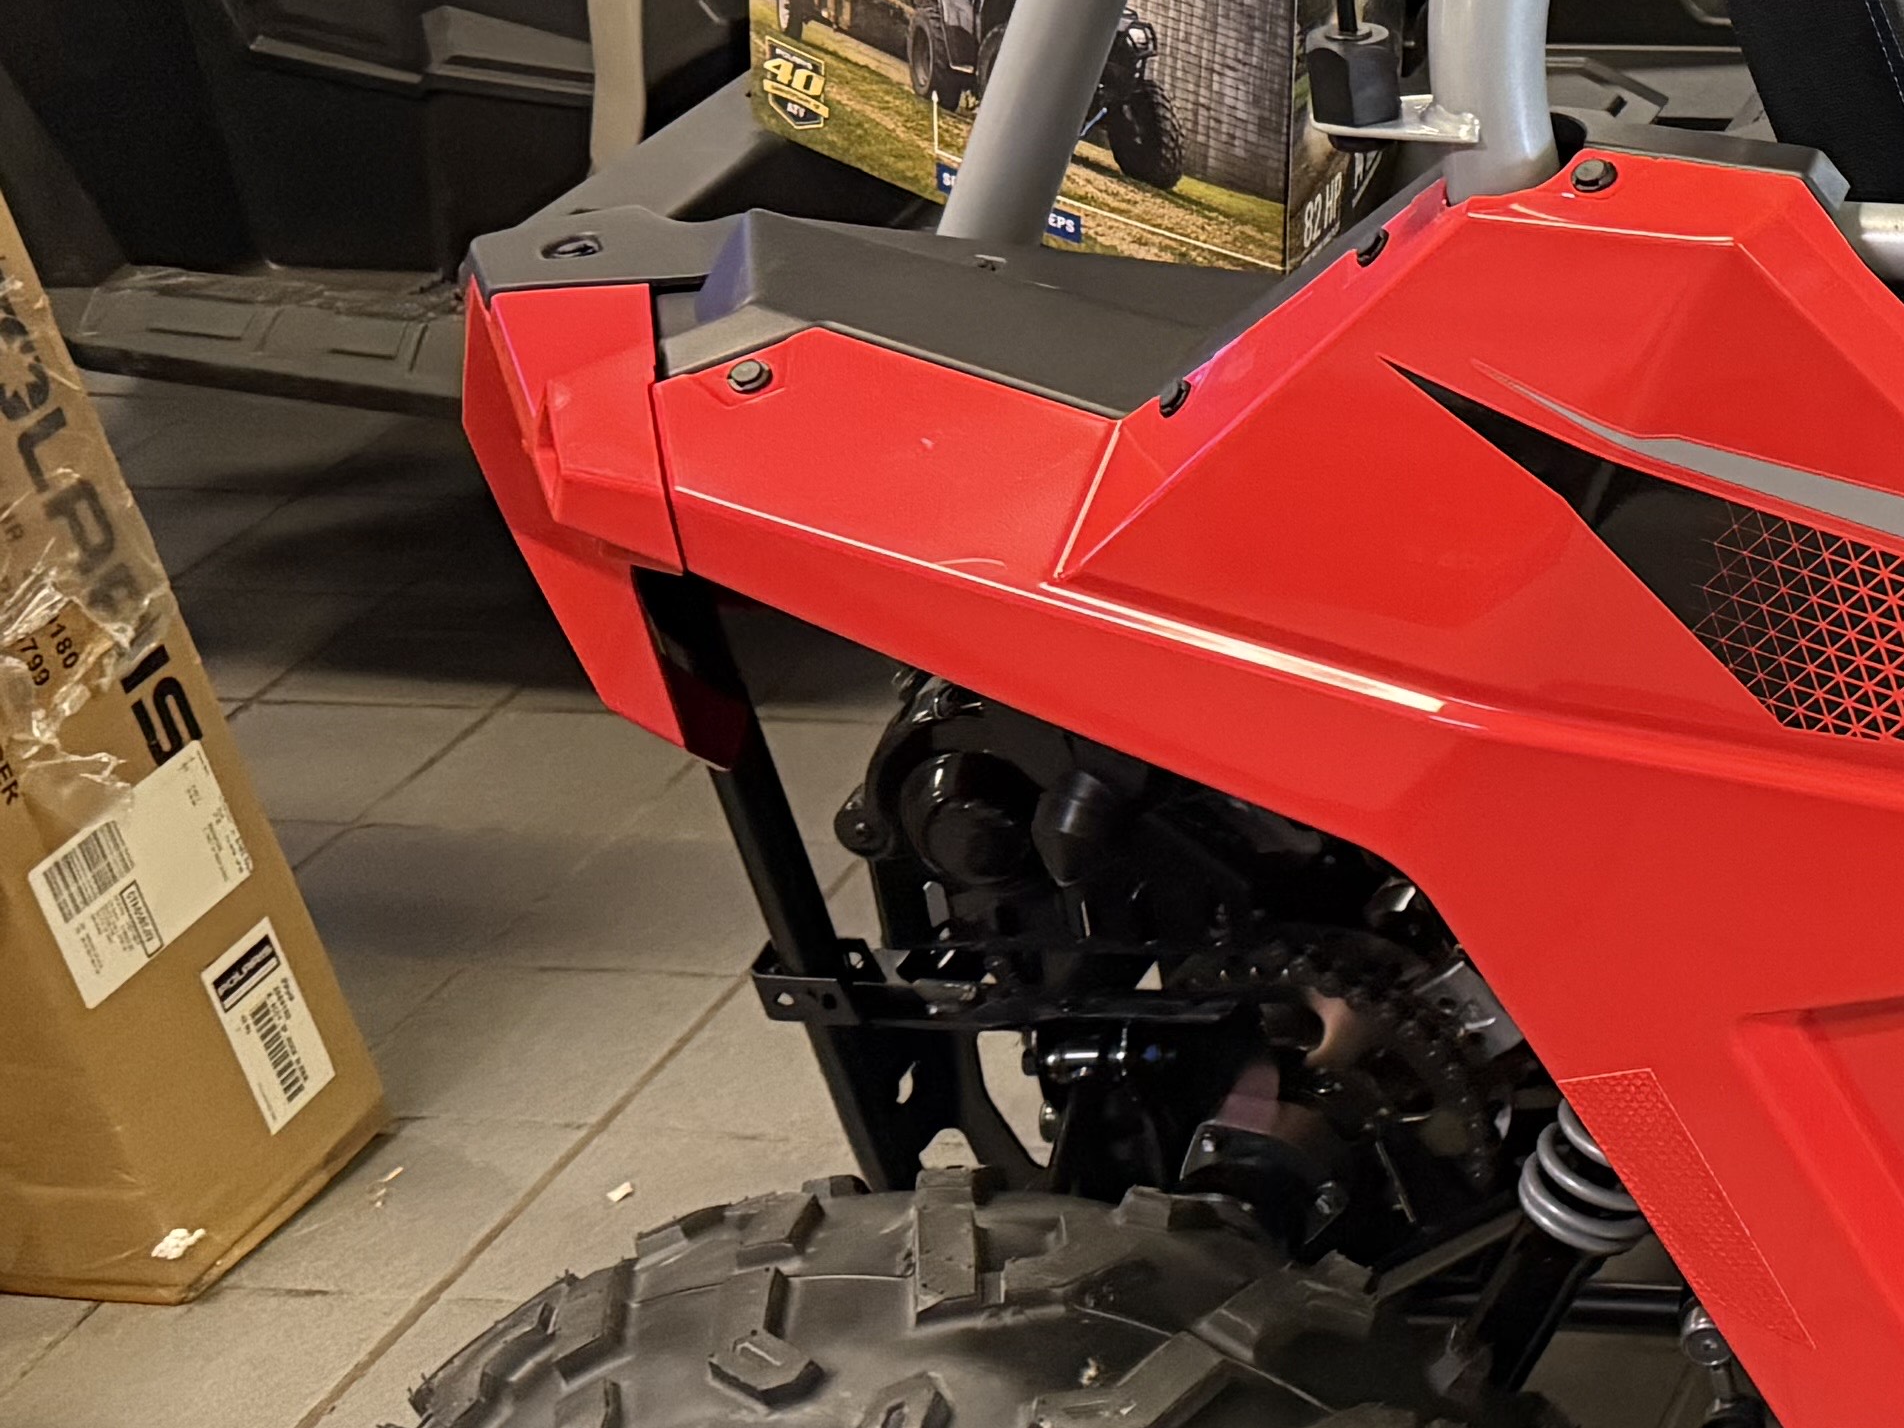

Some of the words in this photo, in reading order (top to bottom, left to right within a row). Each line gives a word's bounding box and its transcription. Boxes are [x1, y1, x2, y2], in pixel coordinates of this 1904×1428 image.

[763, 57, 826, 97] 40
[1047, 213, 1076, 234] EPS
[1303, 192, 1323, 248] 82
[1323, 171, 1343, 230] HP
[16, 636, 51, 687] 799
